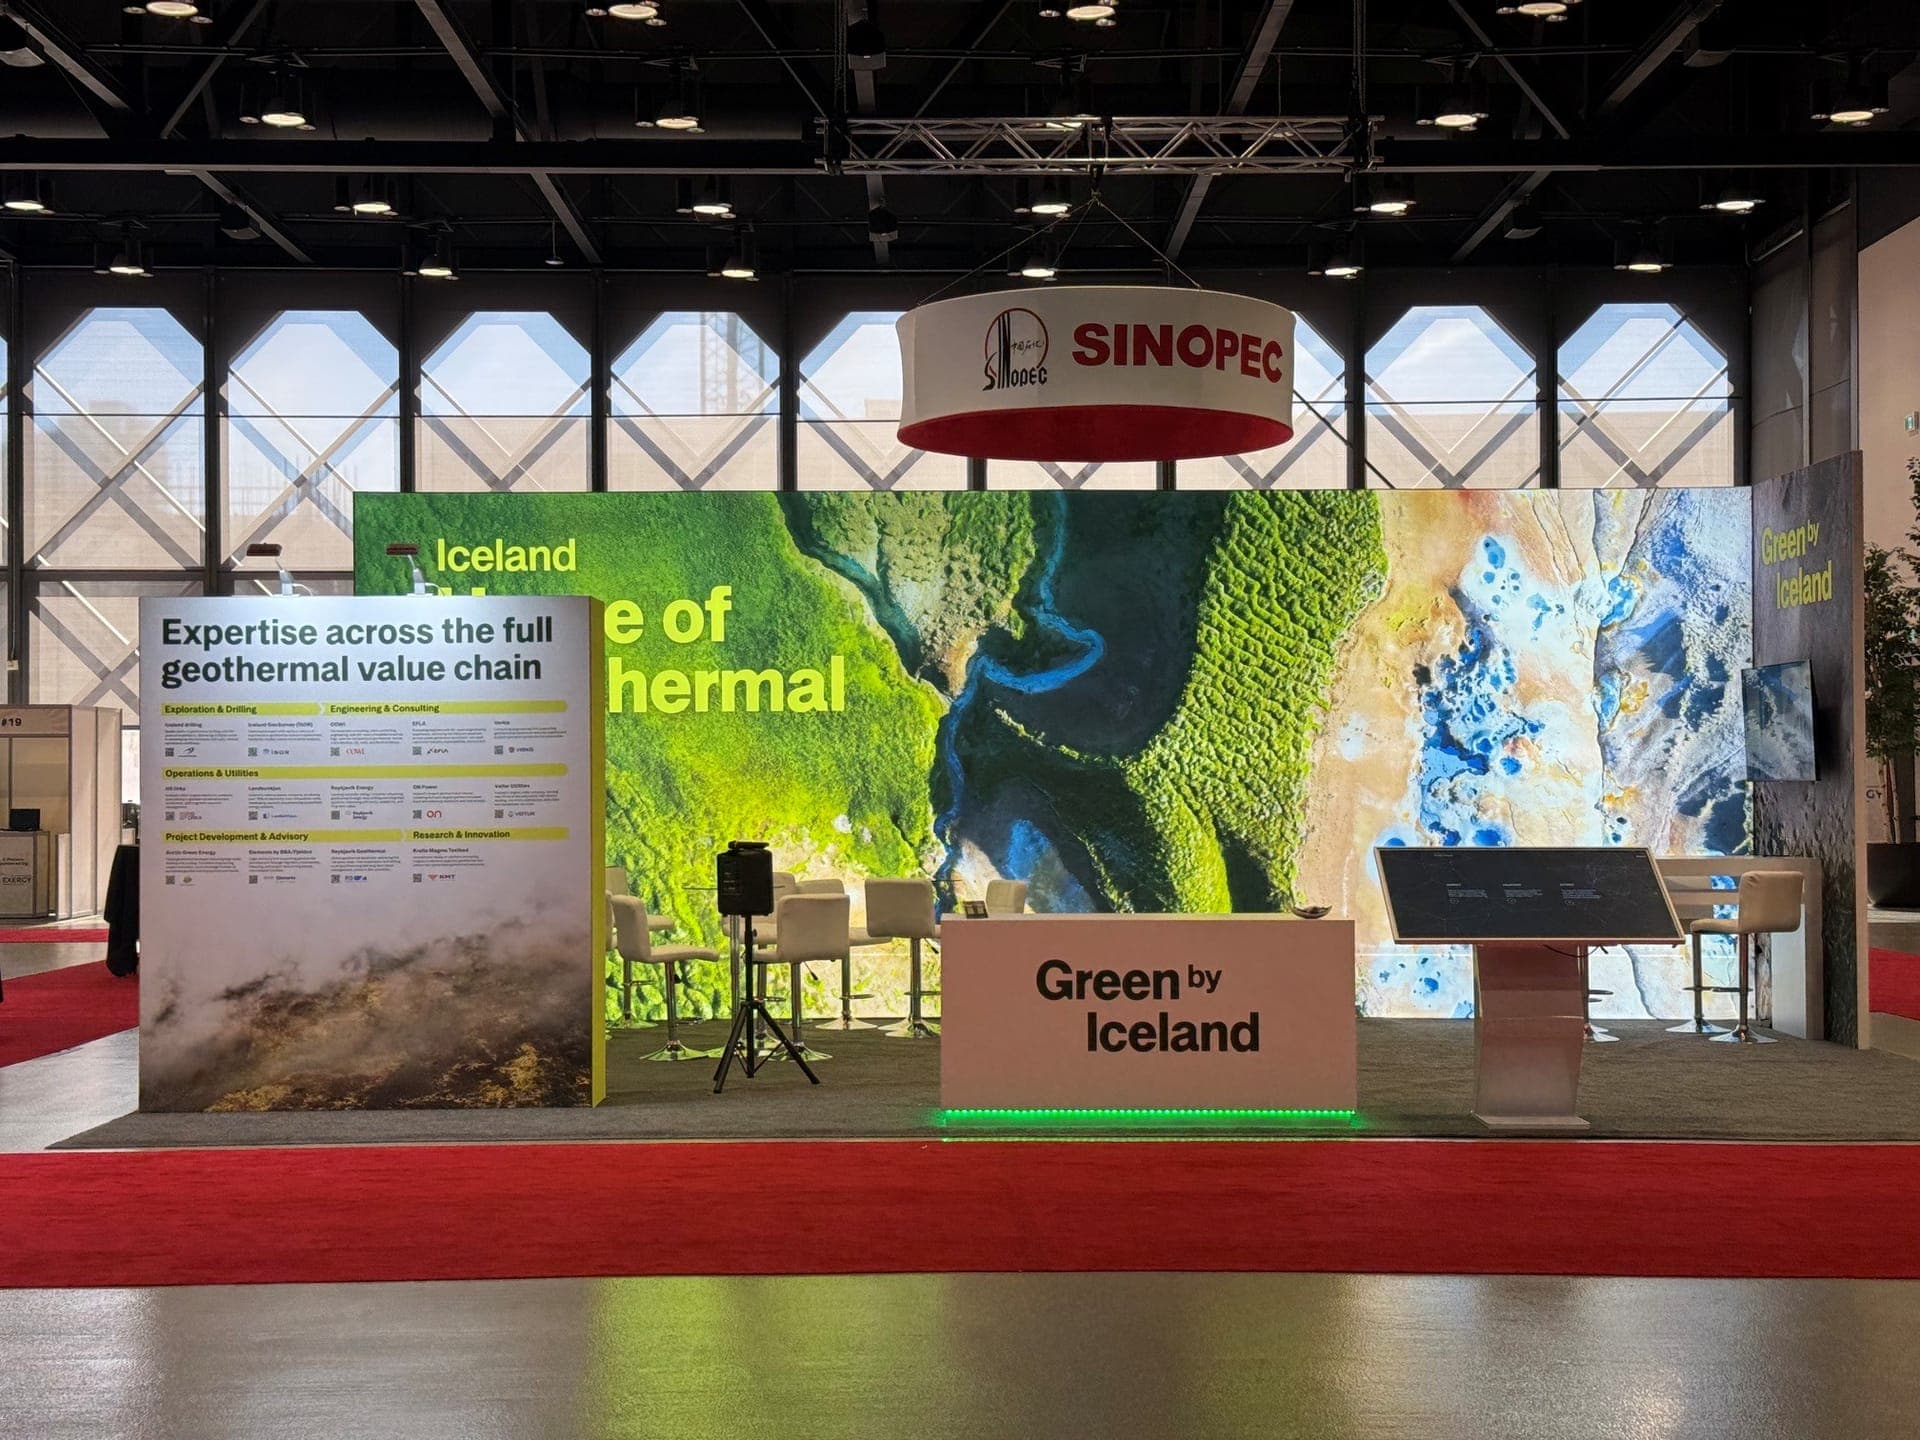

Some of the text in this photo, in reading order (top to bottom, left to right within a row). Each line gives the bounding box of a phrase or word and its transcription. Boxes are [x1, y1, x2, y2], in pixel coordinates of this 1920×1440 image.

[1071, 323, 1283, 383] SINOPEC
[437, 538, 576, 572] Iceland
[1761, 520, 1819, 565] Green by
[1776, 560, 1833, 609] Iceland
[662, 585, 732, 644] of
[162, 616, 552, 651] Expertise across the full
[161, 654, 541, 690] geothermal value chain
[608, 656, 845, 713] hermal
[165, 705, 257, 715] Exploration & Drilling
[330, 704, 440, 714] Engineering & Consulting
[165, 769, 259, 778] Operations & Utilities
[427, 810, 442, 818] on
[165, 832, 309, 842] Project Development & Advisory
[413, 830, 511, 839] Research & Innovation
[1036, 959, 1222, 1000] Green by
[1087, 1012, 1260, 1052] Iceland
